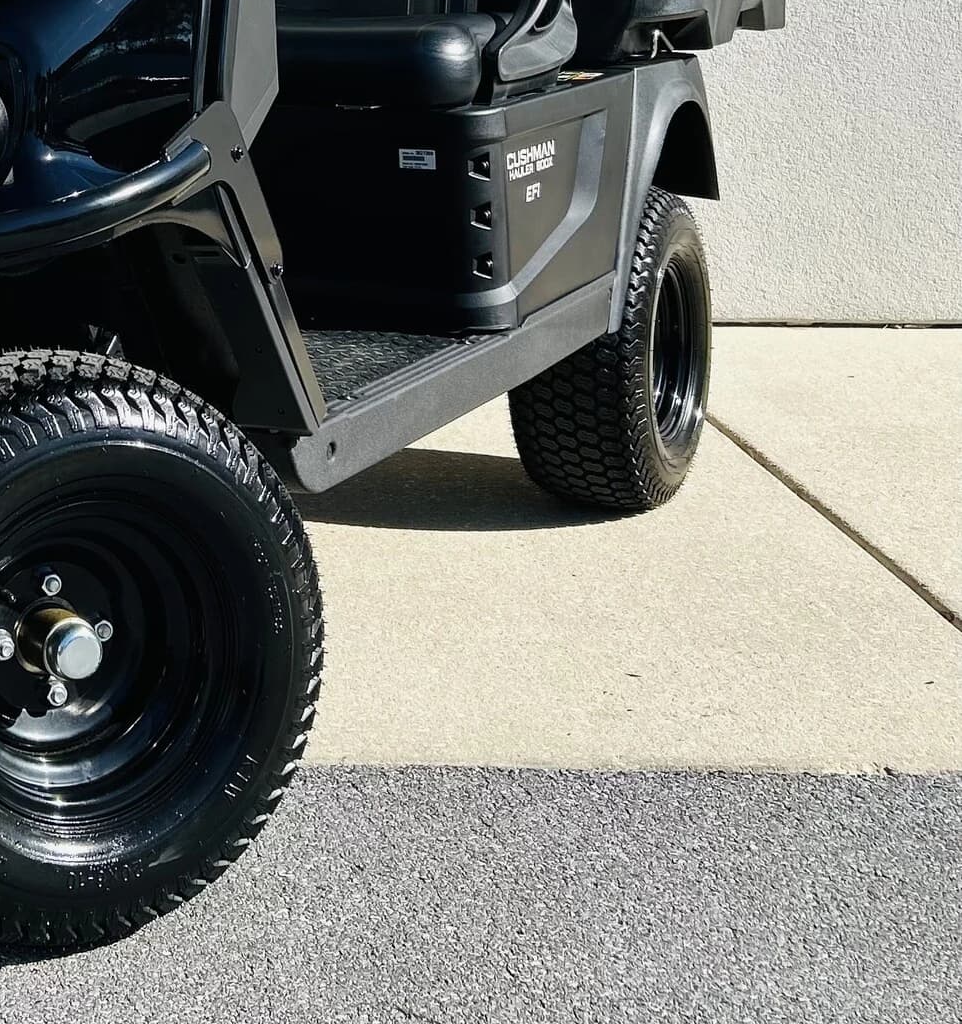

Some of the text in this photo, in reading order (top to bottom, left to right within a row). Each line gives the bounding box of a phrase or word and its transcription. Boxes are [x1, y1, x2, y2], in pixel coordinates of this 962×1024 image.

[506, 139, 555, 170] CUSHMAN
[509, 162, 534, 182] HAULER
[525, 182, 541, 203] EFI
